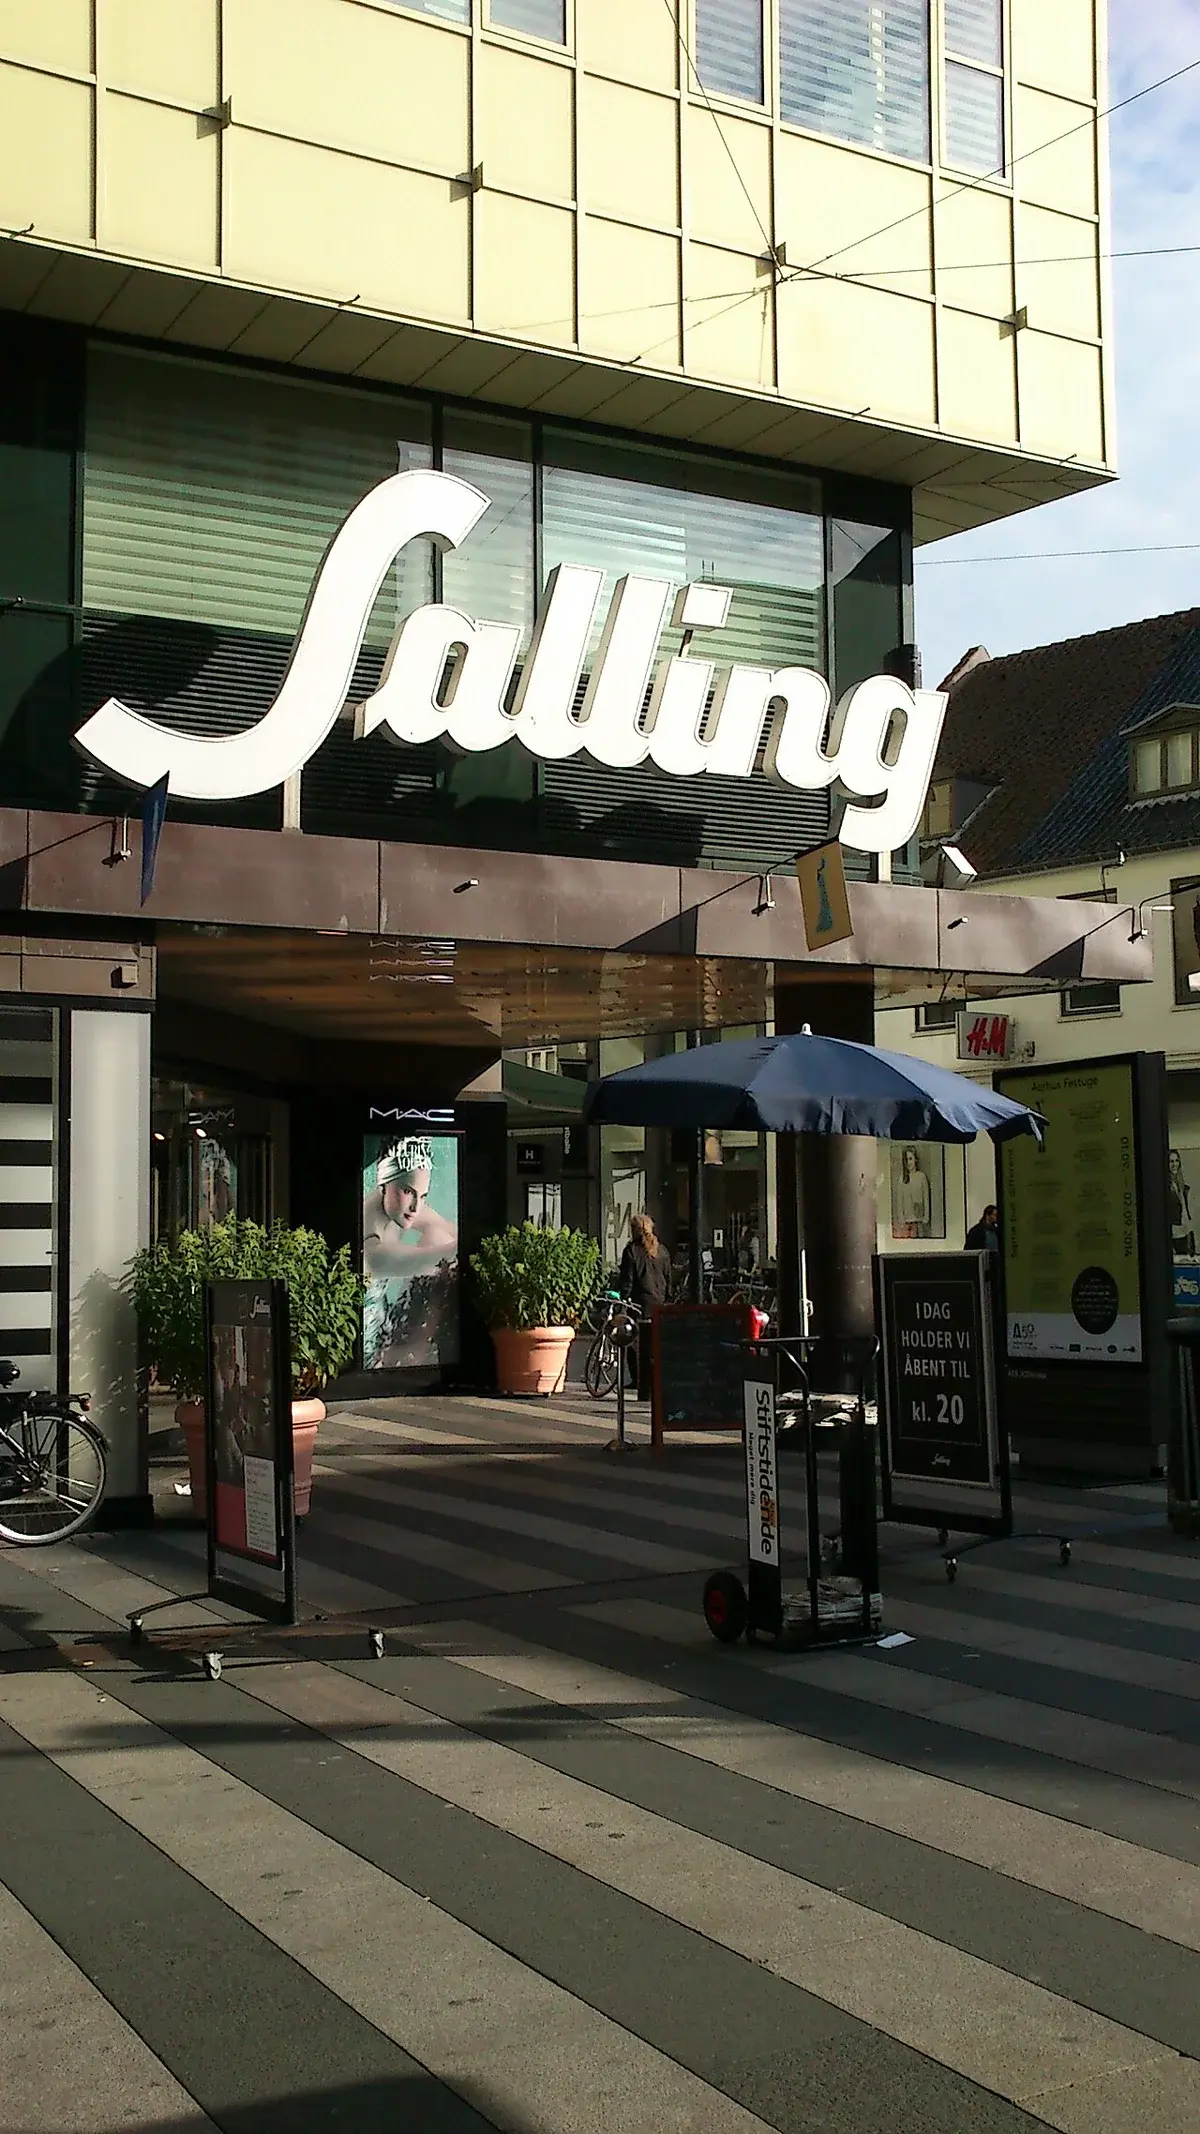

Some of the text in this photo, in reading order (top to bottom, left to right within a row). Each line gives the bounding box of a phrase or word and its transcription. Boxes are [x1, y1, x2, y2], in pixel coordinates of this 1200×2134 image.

[73, 468, 950, 852] Salling
[966, 1016, 1008, 1057] H&M
[916, 1302, 951, 1320] I DAG
[901, 1330, 970, 1349] HOLDER VI
[904, 1353, 970, 1378] ÅBENT TIL
[912, 1394, 964, 1425] kl. 20
[755, 1388, 776, 1555] Stiftstidende
